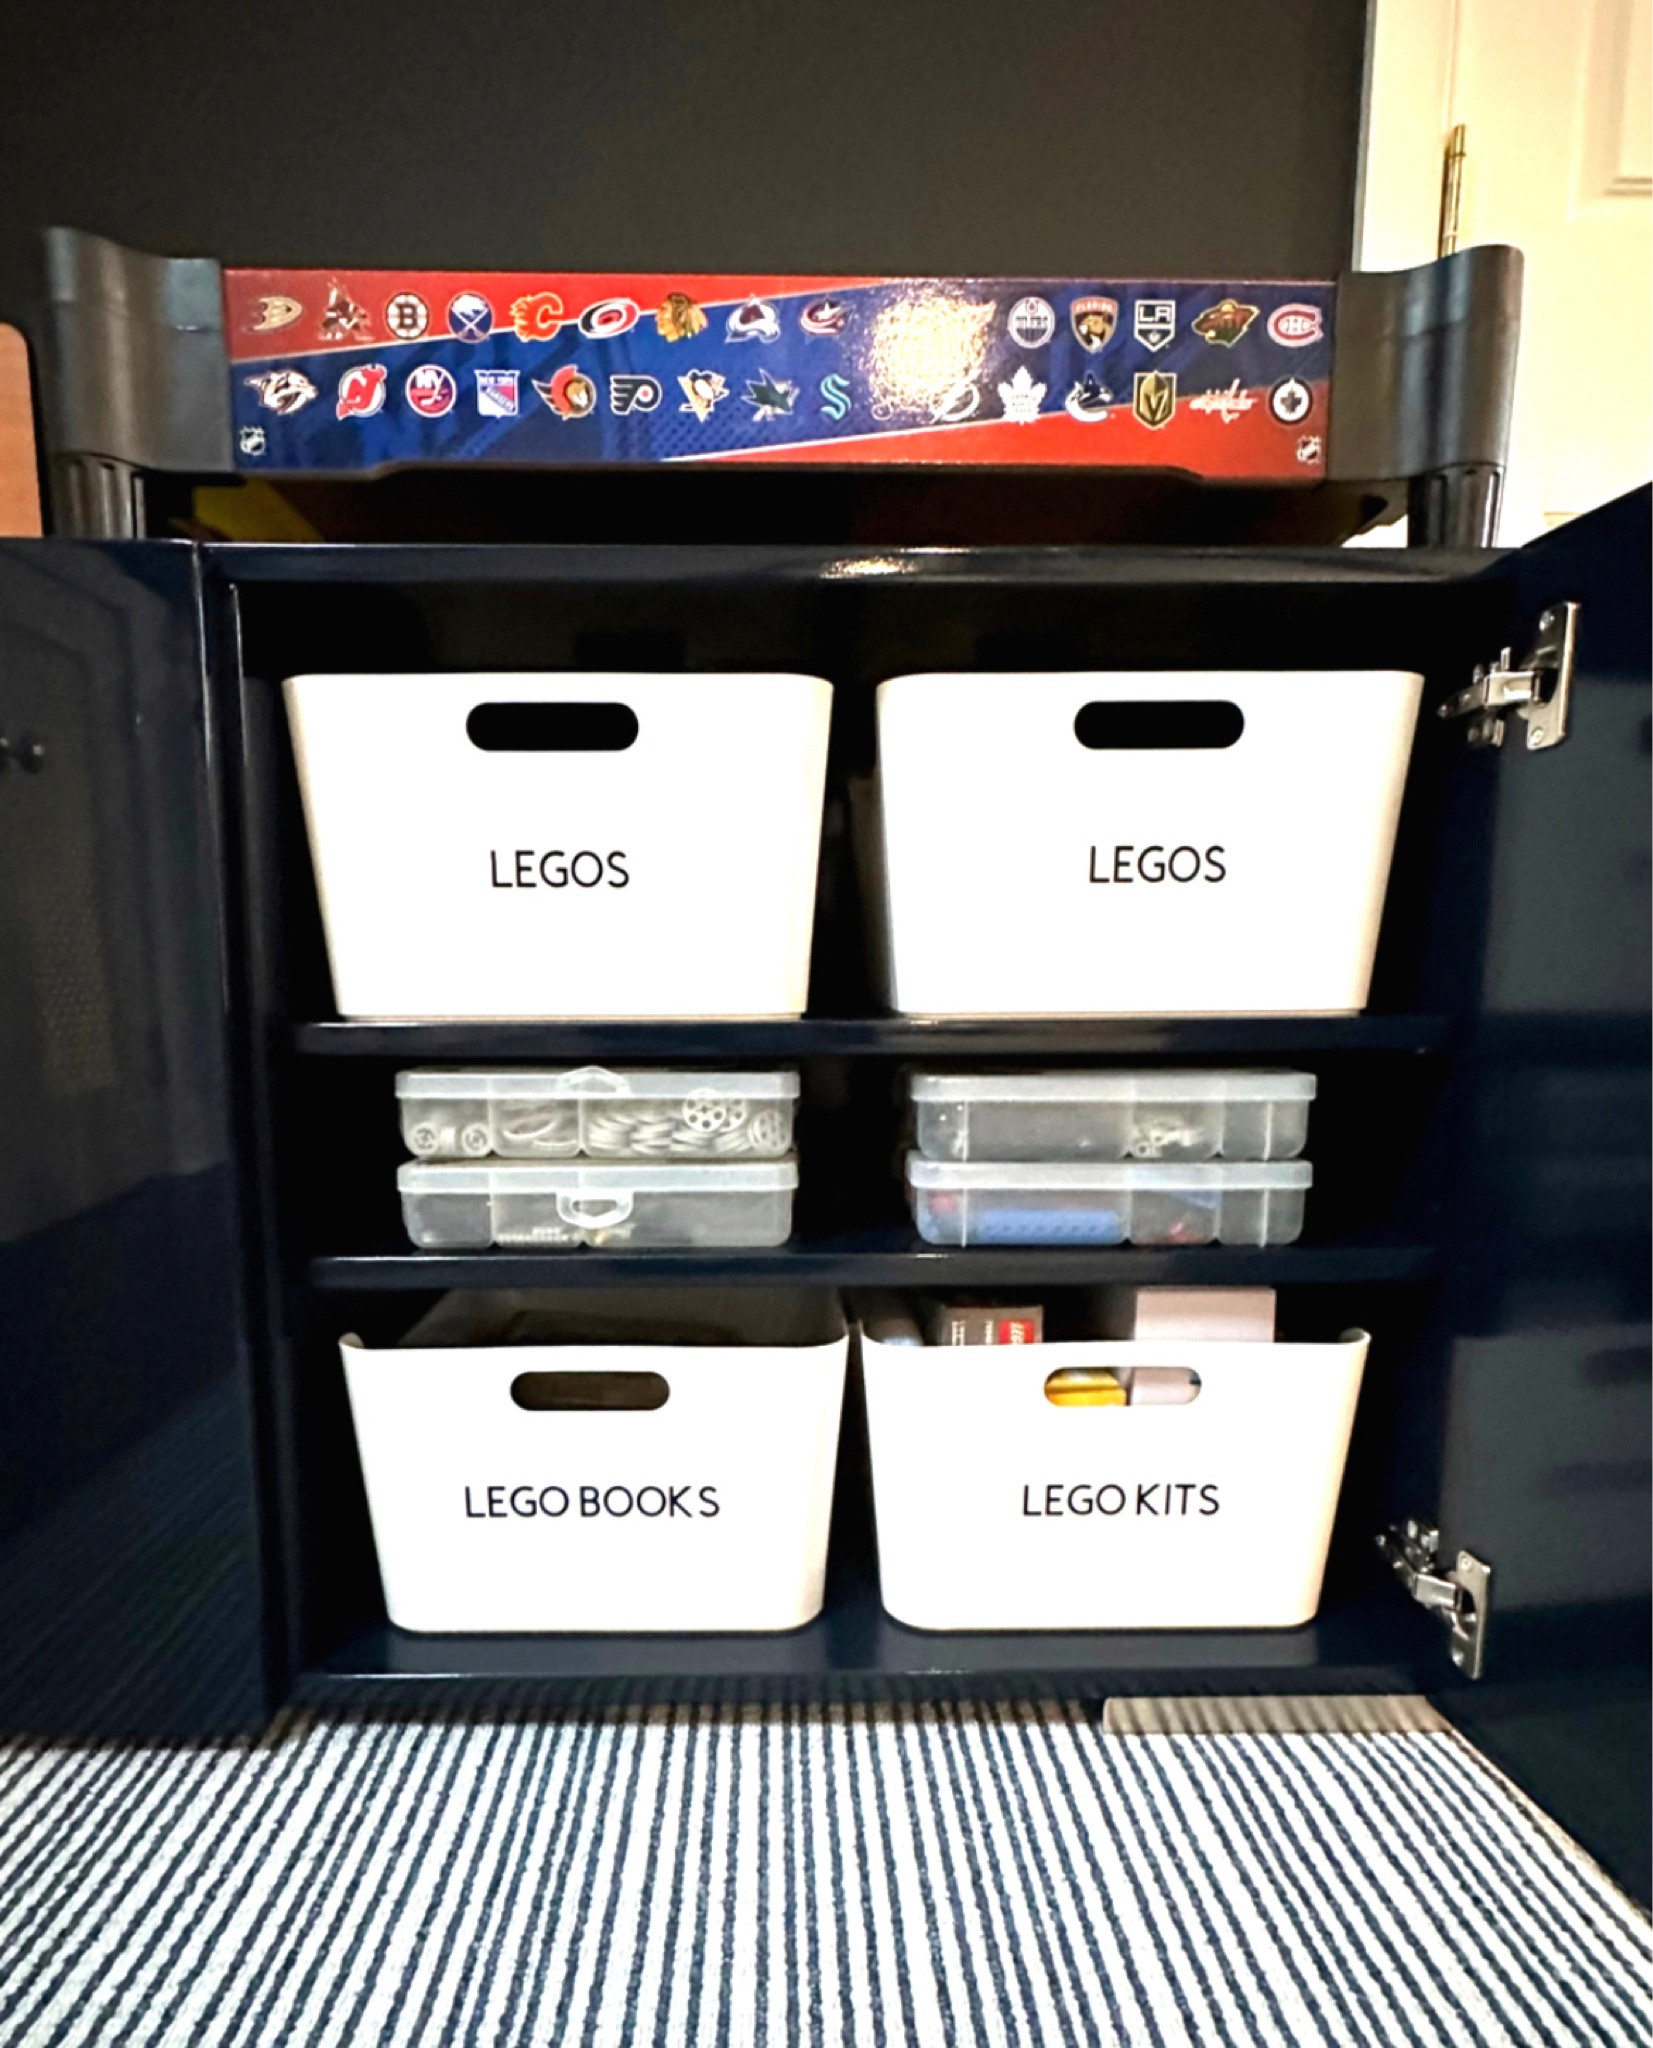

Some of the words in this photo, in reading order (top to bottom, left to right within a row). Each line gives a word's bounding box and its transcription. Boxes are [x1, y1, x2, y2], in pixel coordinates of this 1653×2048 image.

[1138, 305, 1171, 322] LA
[490, 850, 630, 888] LEGOS
[1089, 845, 1227, 884] LEGOS
[465, 1485, 570, 1518] LEGO
[579, 1485, 720, 1518] BOOKS
[1023, 1484, 1126, 1516] LEGO
[1136, 1484, 1220, 1516] KITS
